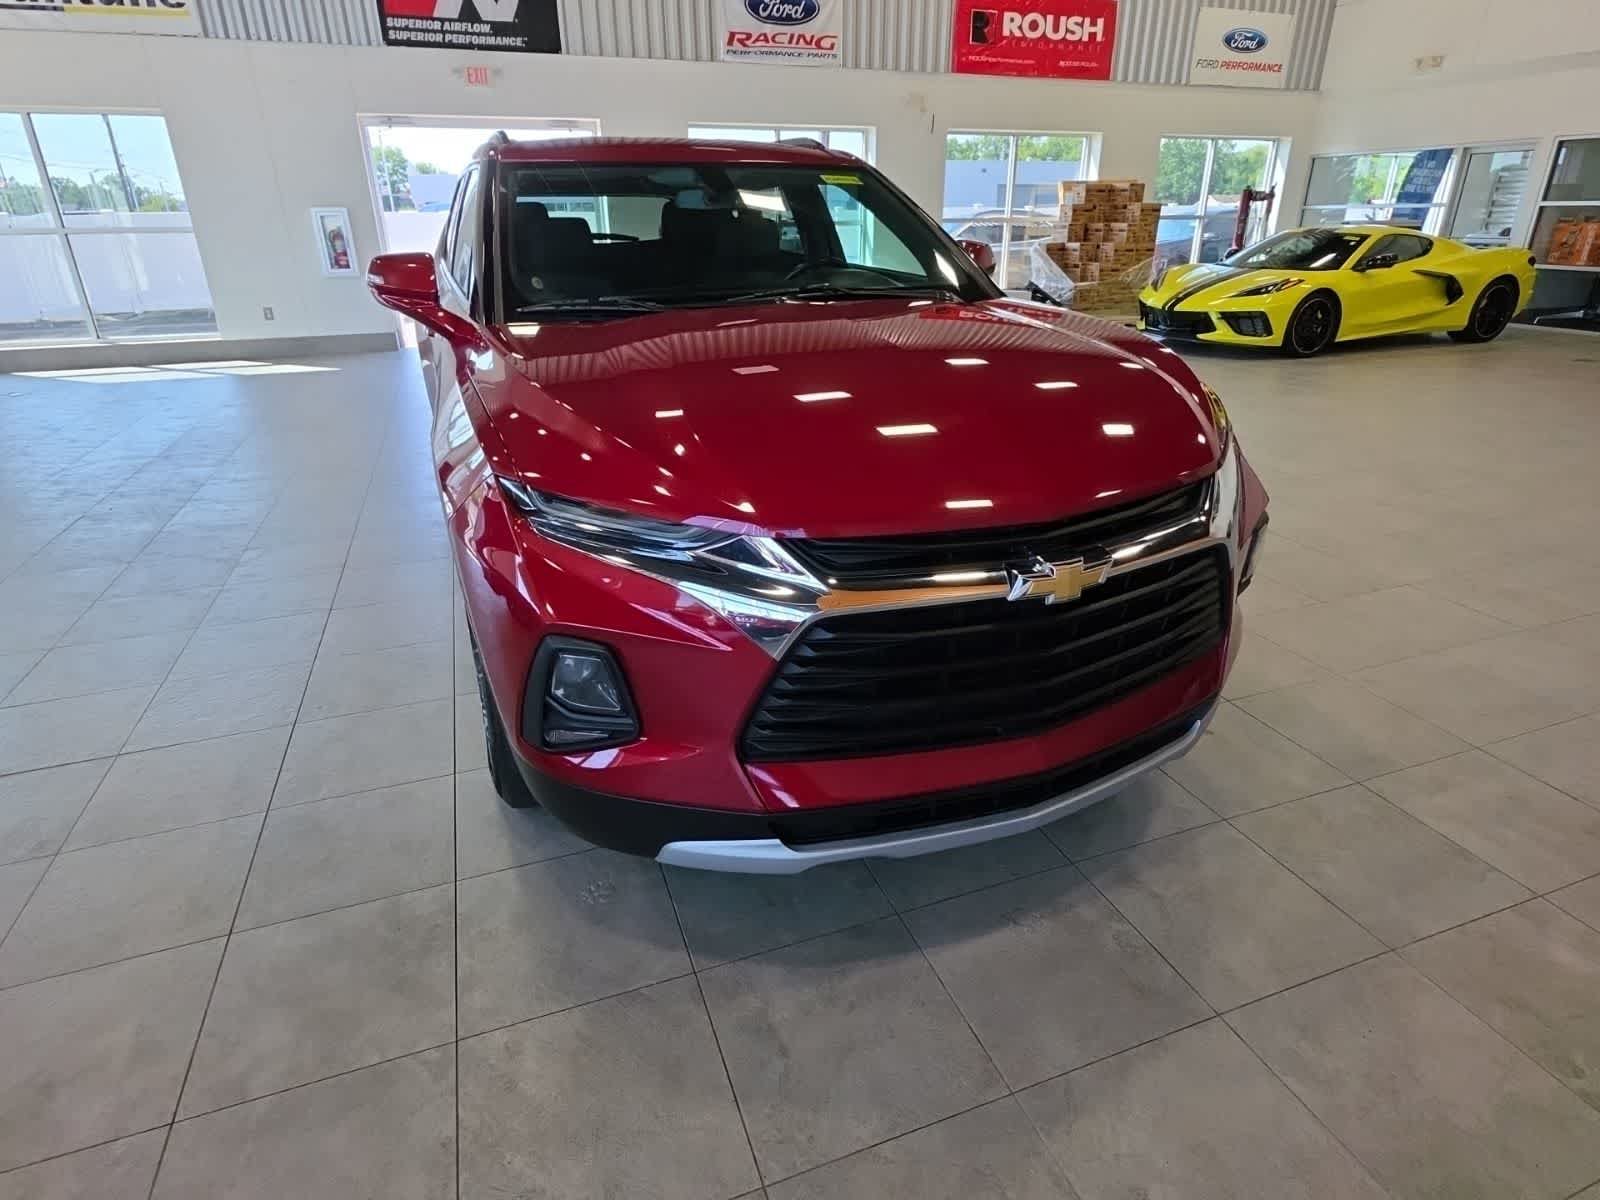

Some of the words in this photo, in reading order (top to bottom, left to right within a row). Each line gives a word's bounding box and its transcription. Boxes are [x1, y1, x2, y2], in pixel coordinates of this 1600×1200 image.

[386, 17, 442, 31] SUPERIOR
[443, 21, 493, 34] AIRFLOW.
[1002, 11, 1105, 42] ROUSH
[388, 29, 443, 43] SUPERIOR
[445, 35, 526, 47] PERFORMANCE.
[726, 31, 838, 51] RACING
[1230, 32, 1259, 49] Ford
[727, 49, 806, 58] PERFORMANCE
[807, 51, 838, 59] PARTS
[1195, 59, 1219, 70] FORD
[1220, 60, 1283, 73] PERFORMANCE
[466, 66, 489, 86] EXIT
